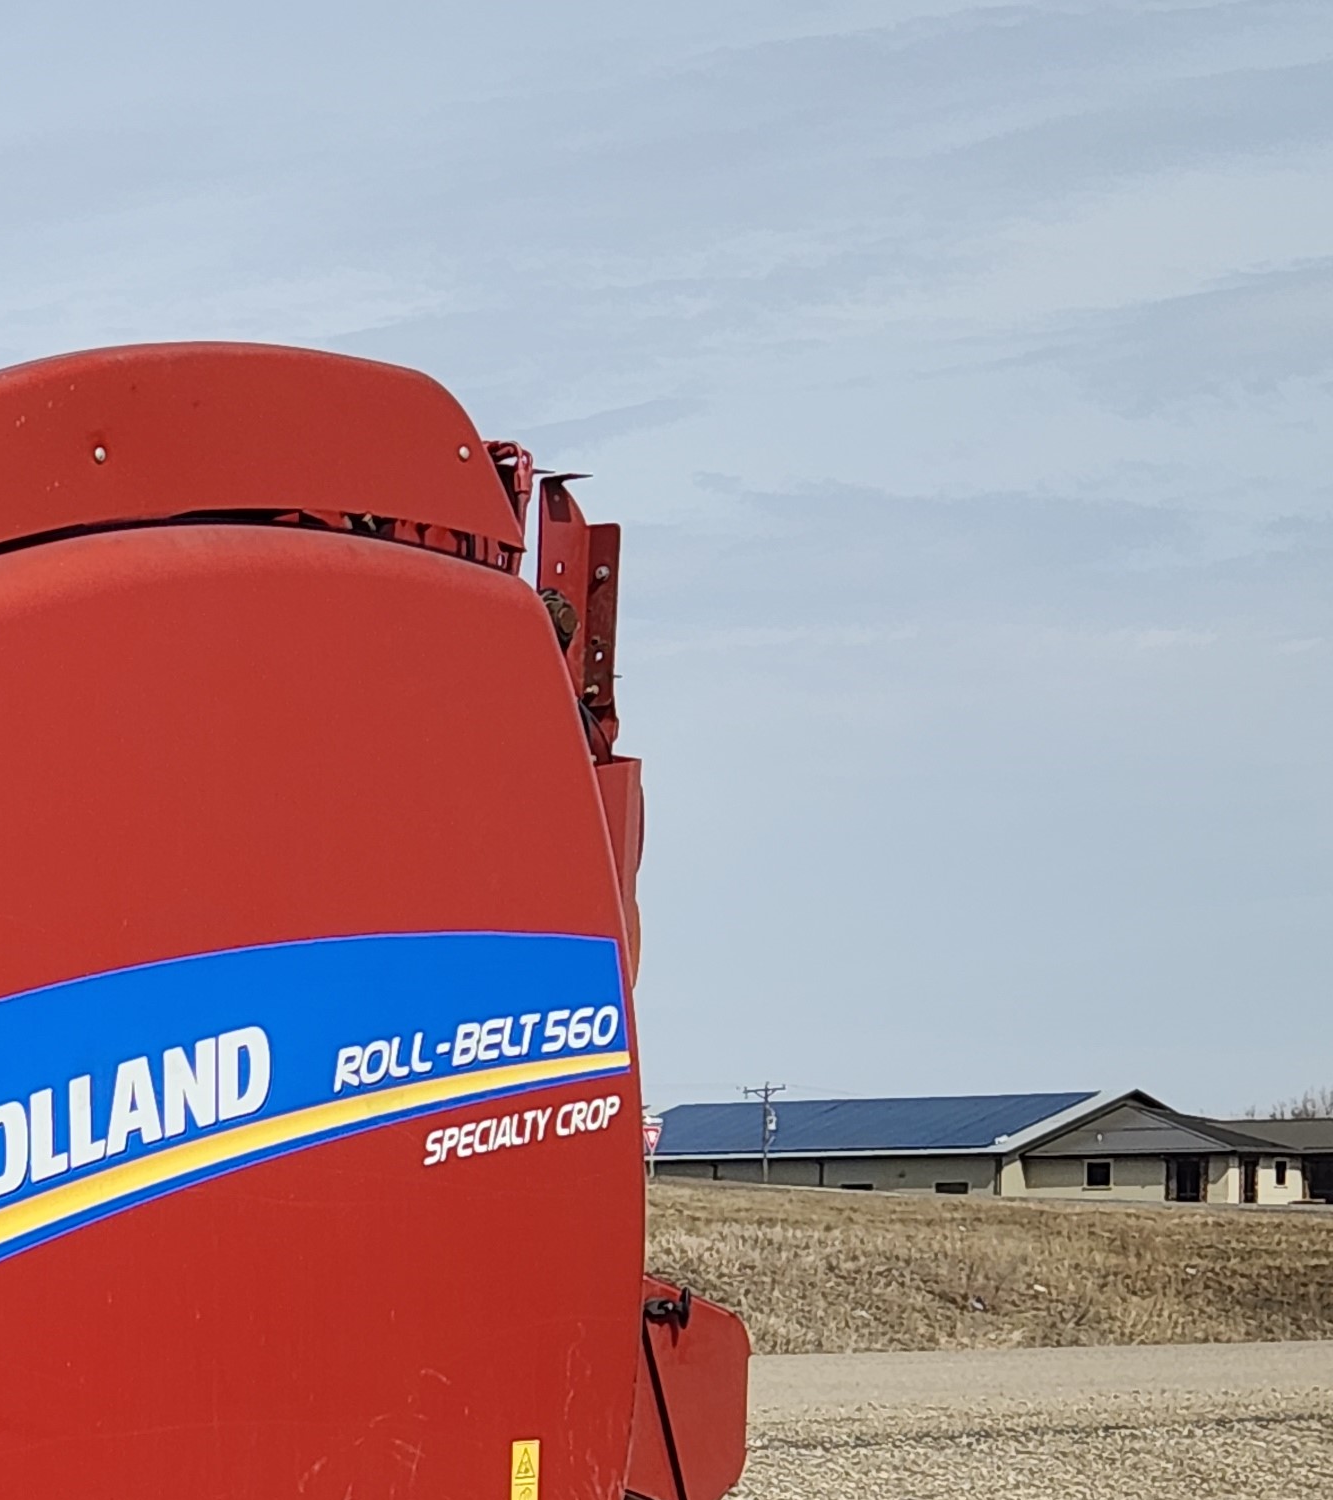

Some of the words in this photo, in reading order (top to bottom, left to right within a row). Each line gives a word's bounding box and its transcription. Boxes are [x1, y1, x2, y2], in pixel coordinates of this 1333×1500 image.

[334, 1013, 541, 1092] ROLL-BELT
[541, 1005, 619, 1053] 560
[423, 1107, 553, 1166] SPECIALTY
[556, 1095, 621, 1136] CROP
